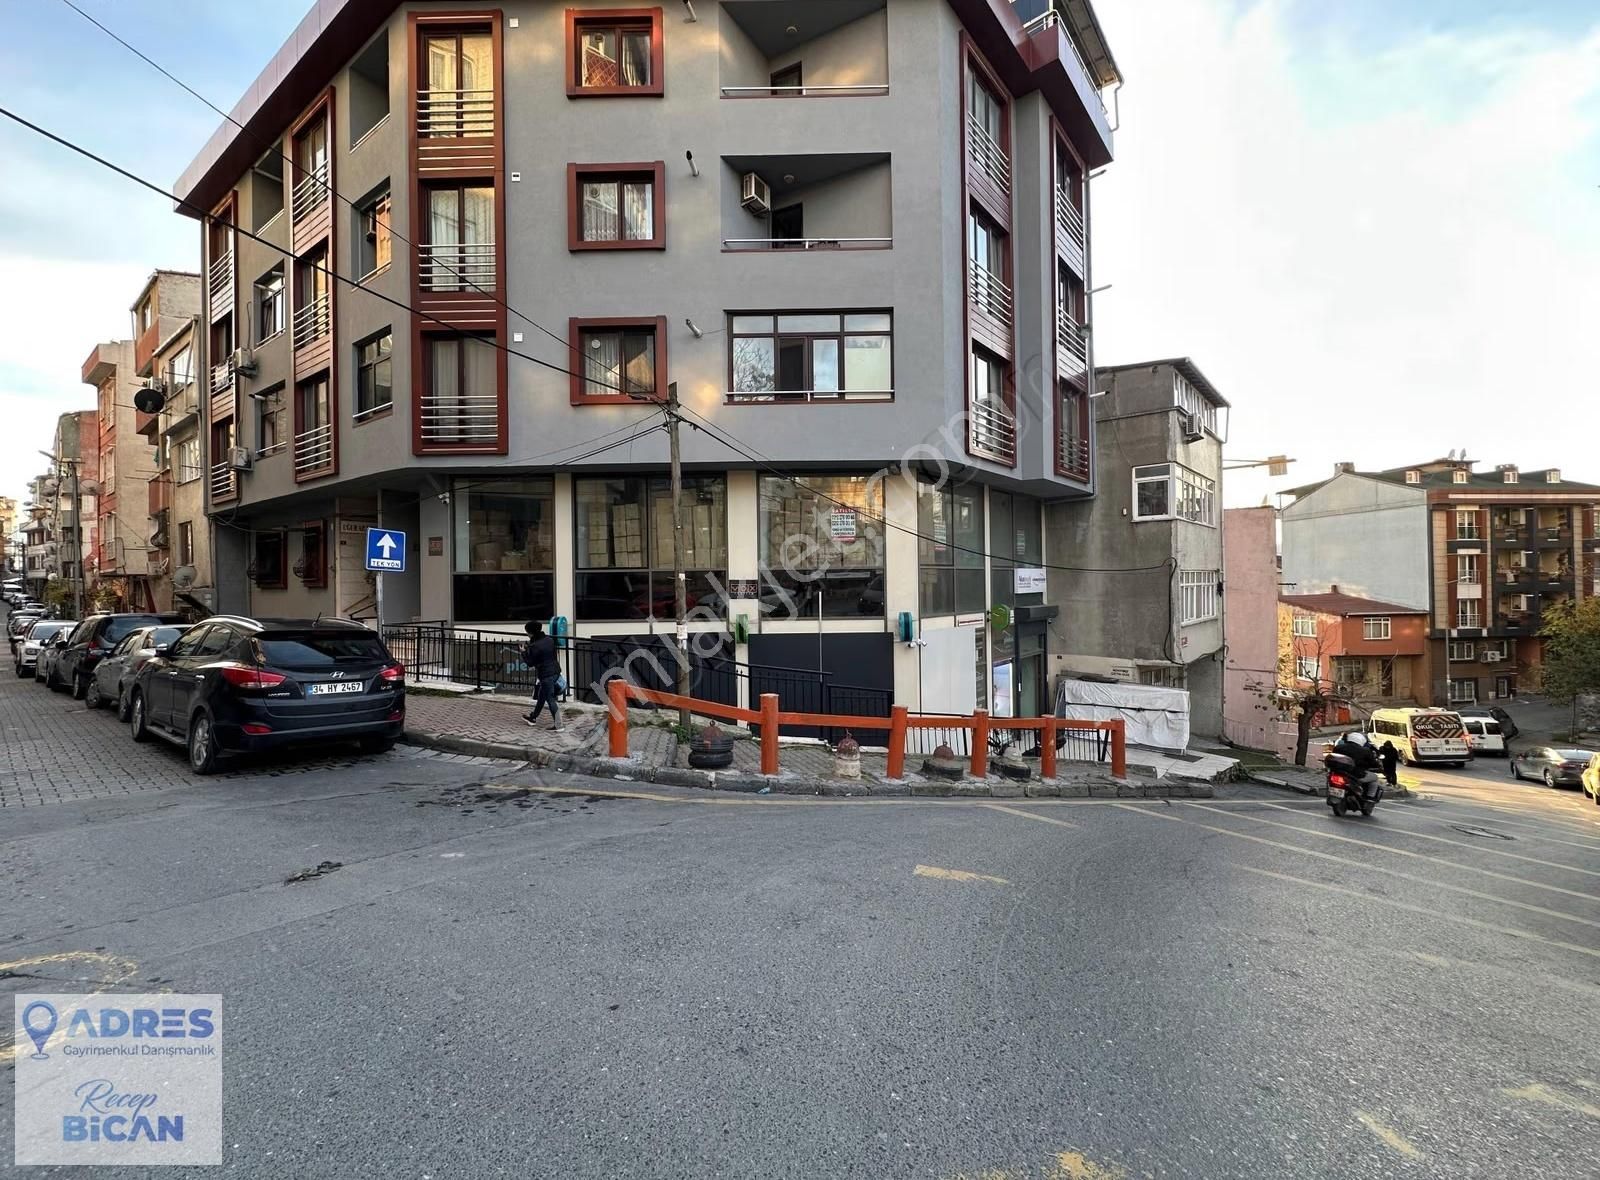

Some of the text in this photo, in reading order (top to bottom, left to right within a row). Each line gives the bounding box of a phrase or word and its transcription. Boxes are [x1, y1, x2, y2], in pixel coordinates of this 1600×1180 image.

[313, 682, 361, 693] 34 HY 2467
